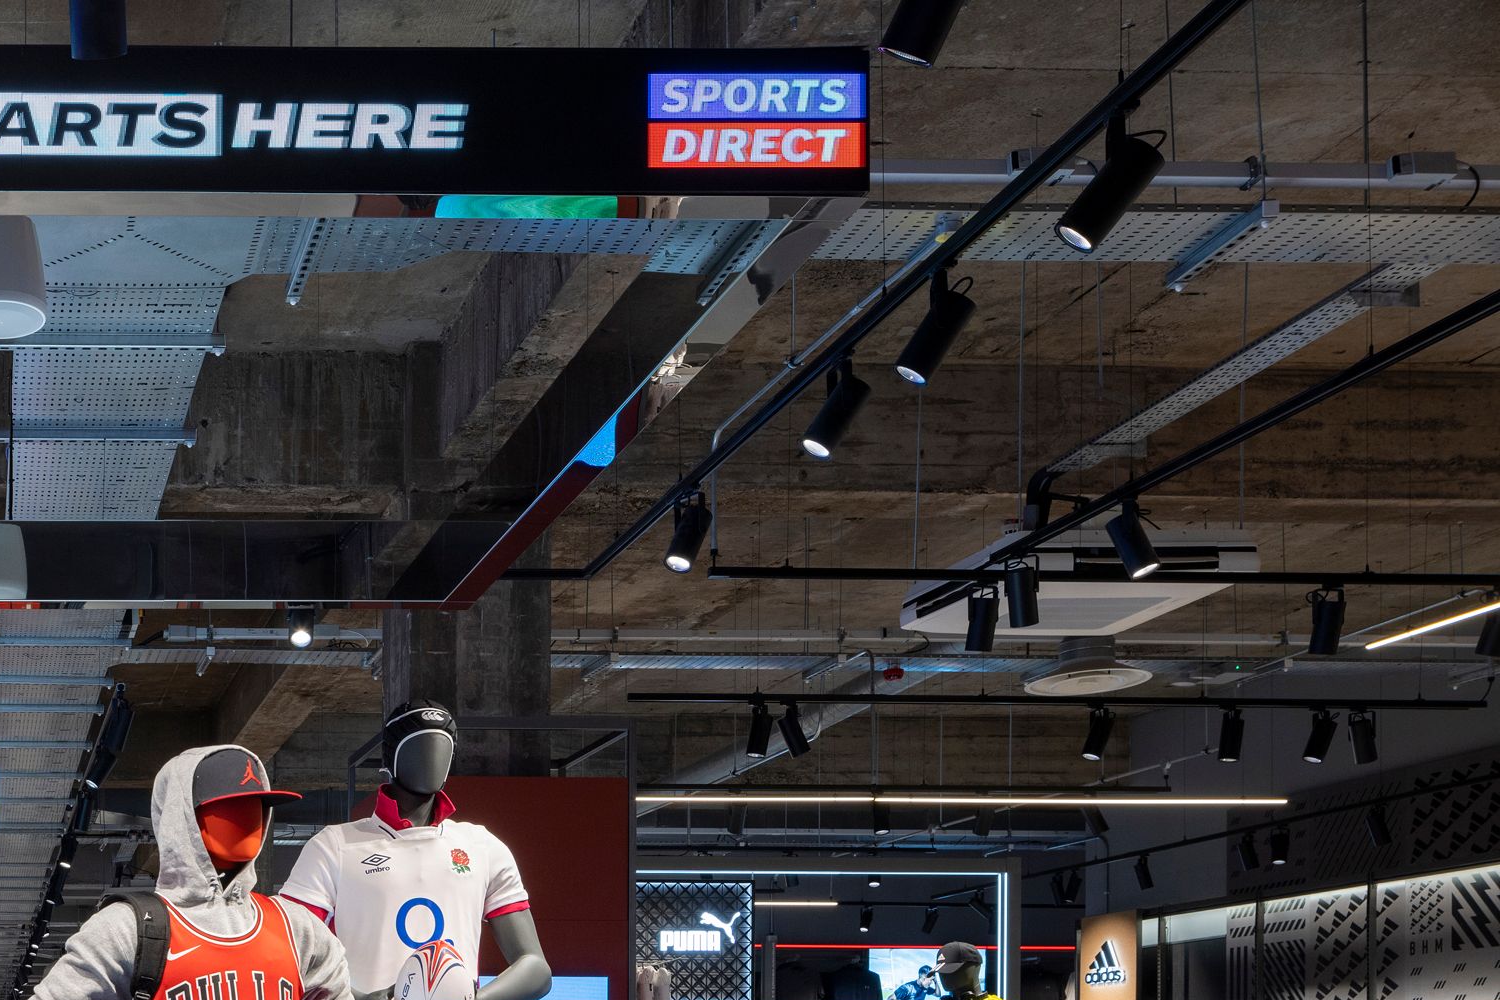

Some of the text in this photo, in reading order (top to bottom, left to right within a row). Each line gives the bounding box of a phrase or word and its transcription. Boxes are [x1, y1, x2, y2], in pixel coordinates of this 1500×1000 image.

[661, 79, 847, 112] SPORTS
[232, 103, 469, 149] HERE
[661, 128, 846, 162] DIRECT
[365, 865, 390, 875] umbro
[660, 930, 720, 951] PUMA
[1085, 966, 1122, 984] adidas
